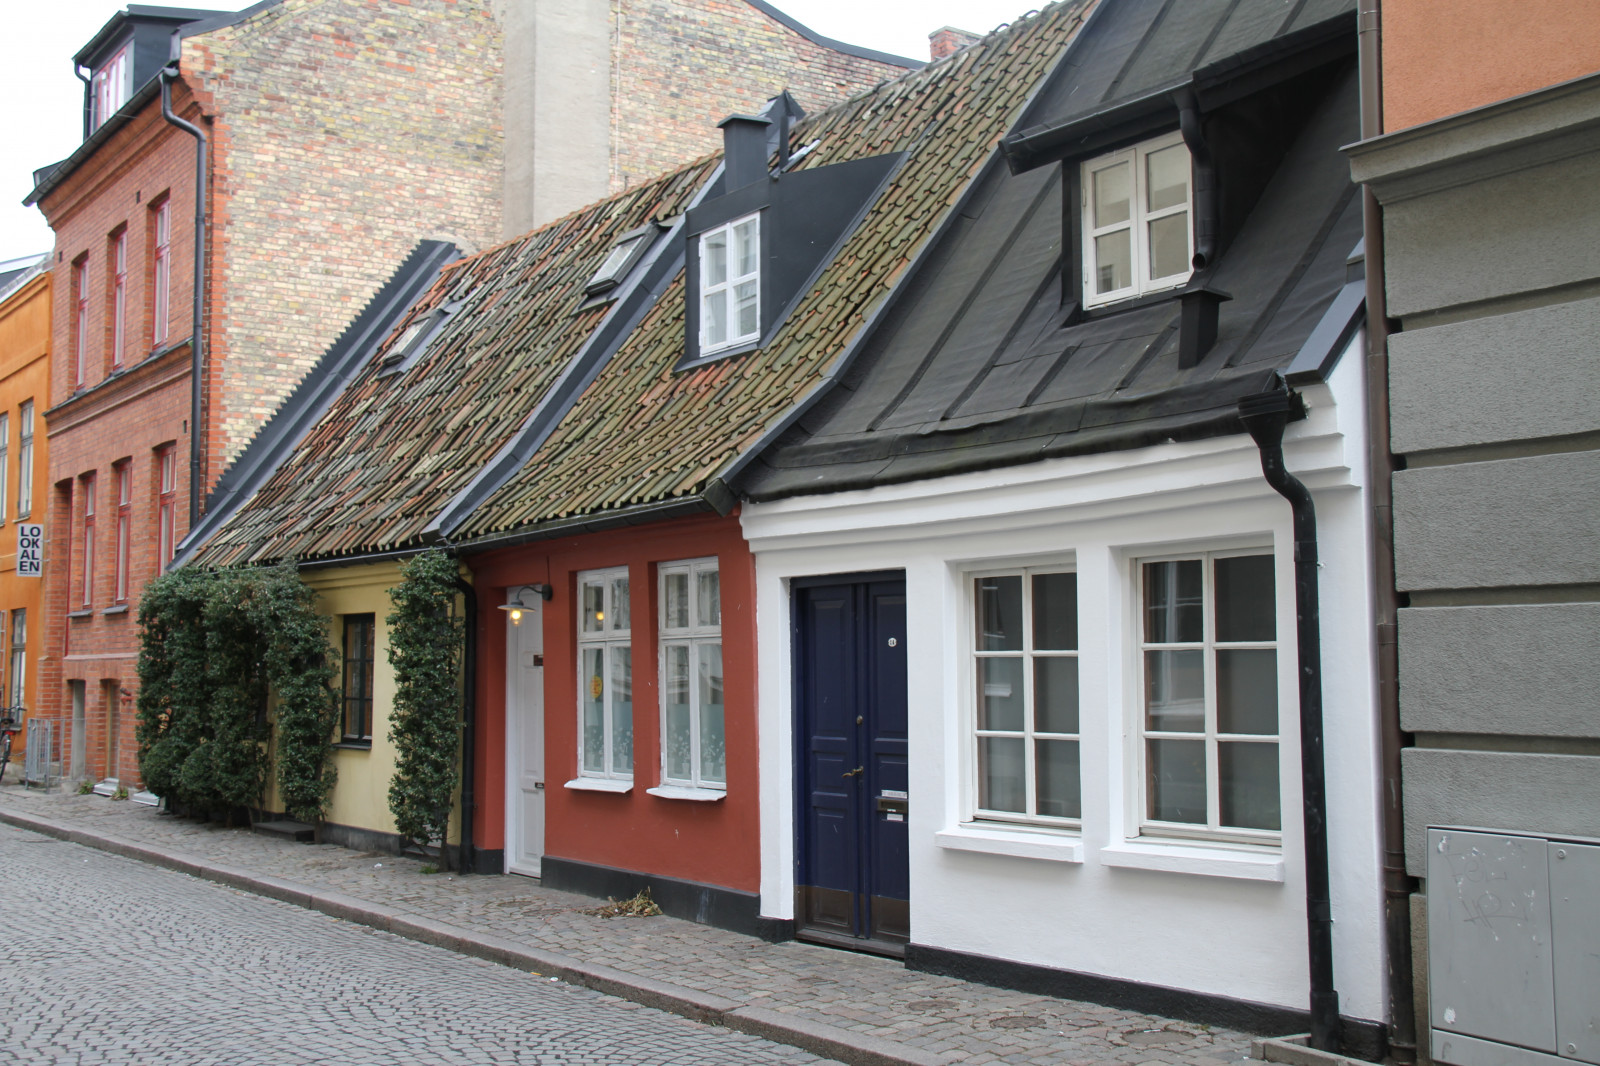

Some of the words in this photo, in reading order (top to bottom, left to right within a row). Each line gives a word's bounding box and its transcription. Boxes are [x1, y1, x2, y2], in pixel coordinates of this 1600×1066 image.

[20, 526, 41, 537] LO
[20, 537, 40, 548] OK
[20, 549, 39, 560] AL
[19, 561, 39, 571] EN
